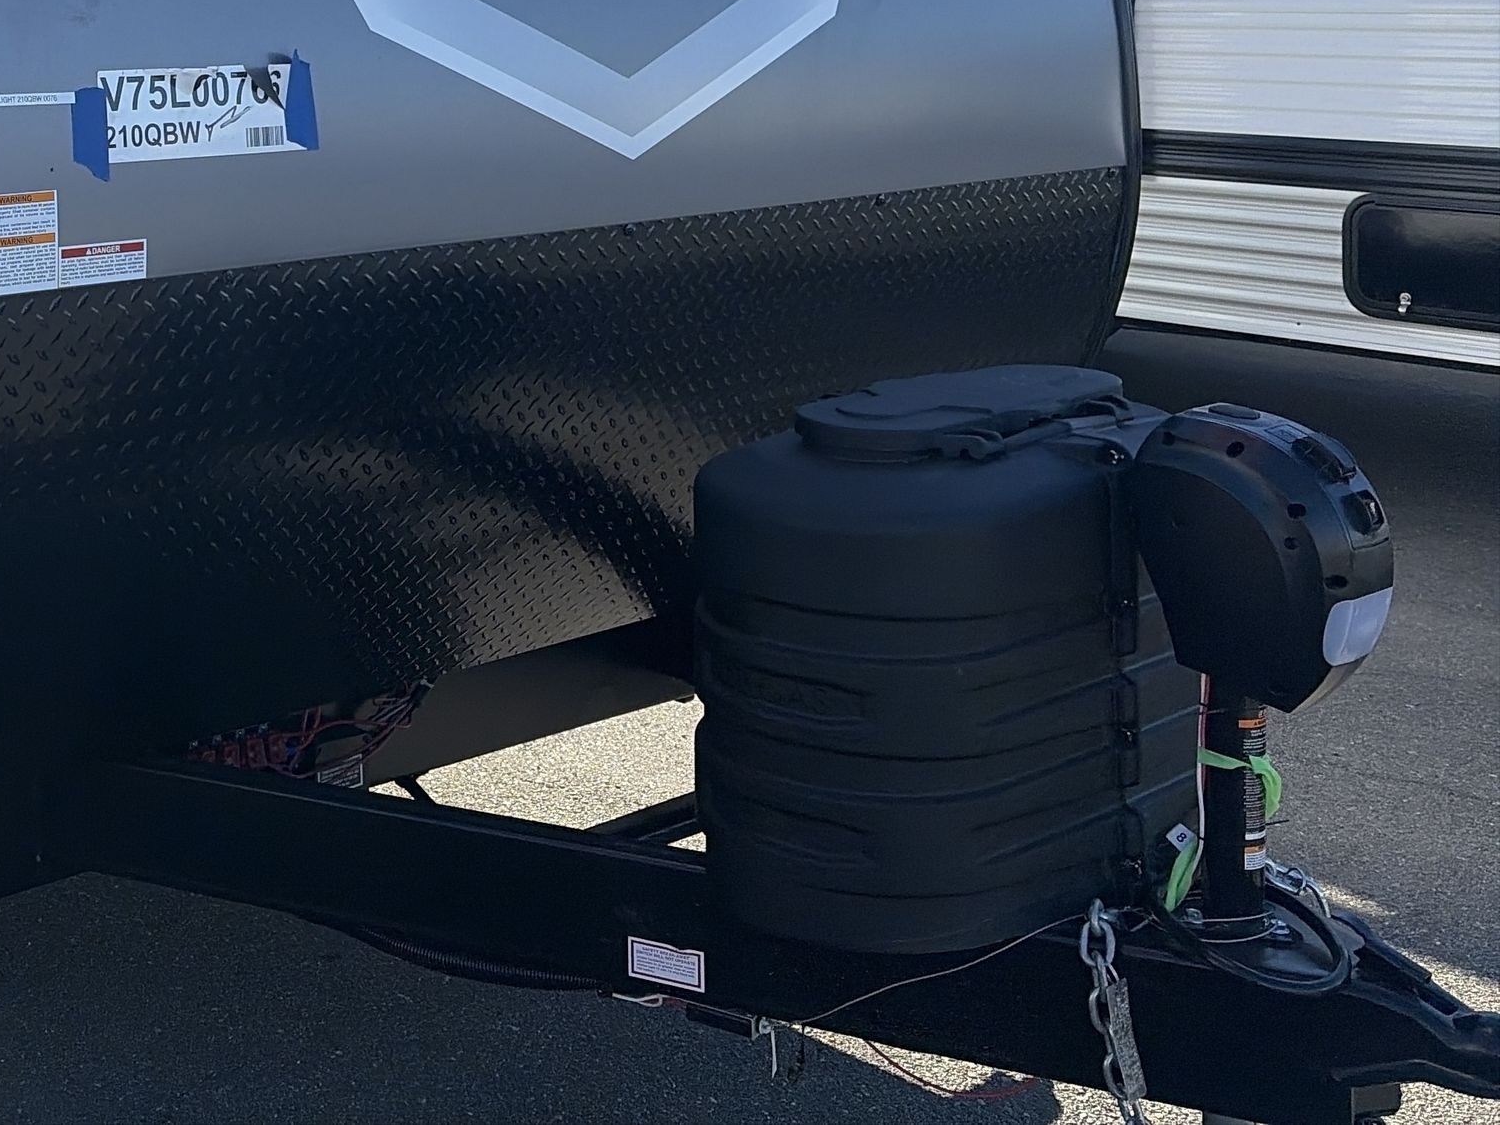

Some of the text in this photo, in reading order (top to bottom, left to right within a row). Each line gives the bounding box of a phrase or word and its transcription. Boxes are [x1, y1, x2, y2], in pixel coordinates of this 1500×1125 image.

[107, 121, 200, 148] 210QBW
[0, 194, 32, 204] WARNING
[0, 236, 33, 246] WARNING
[91, 245, 120, 255] DANGER
